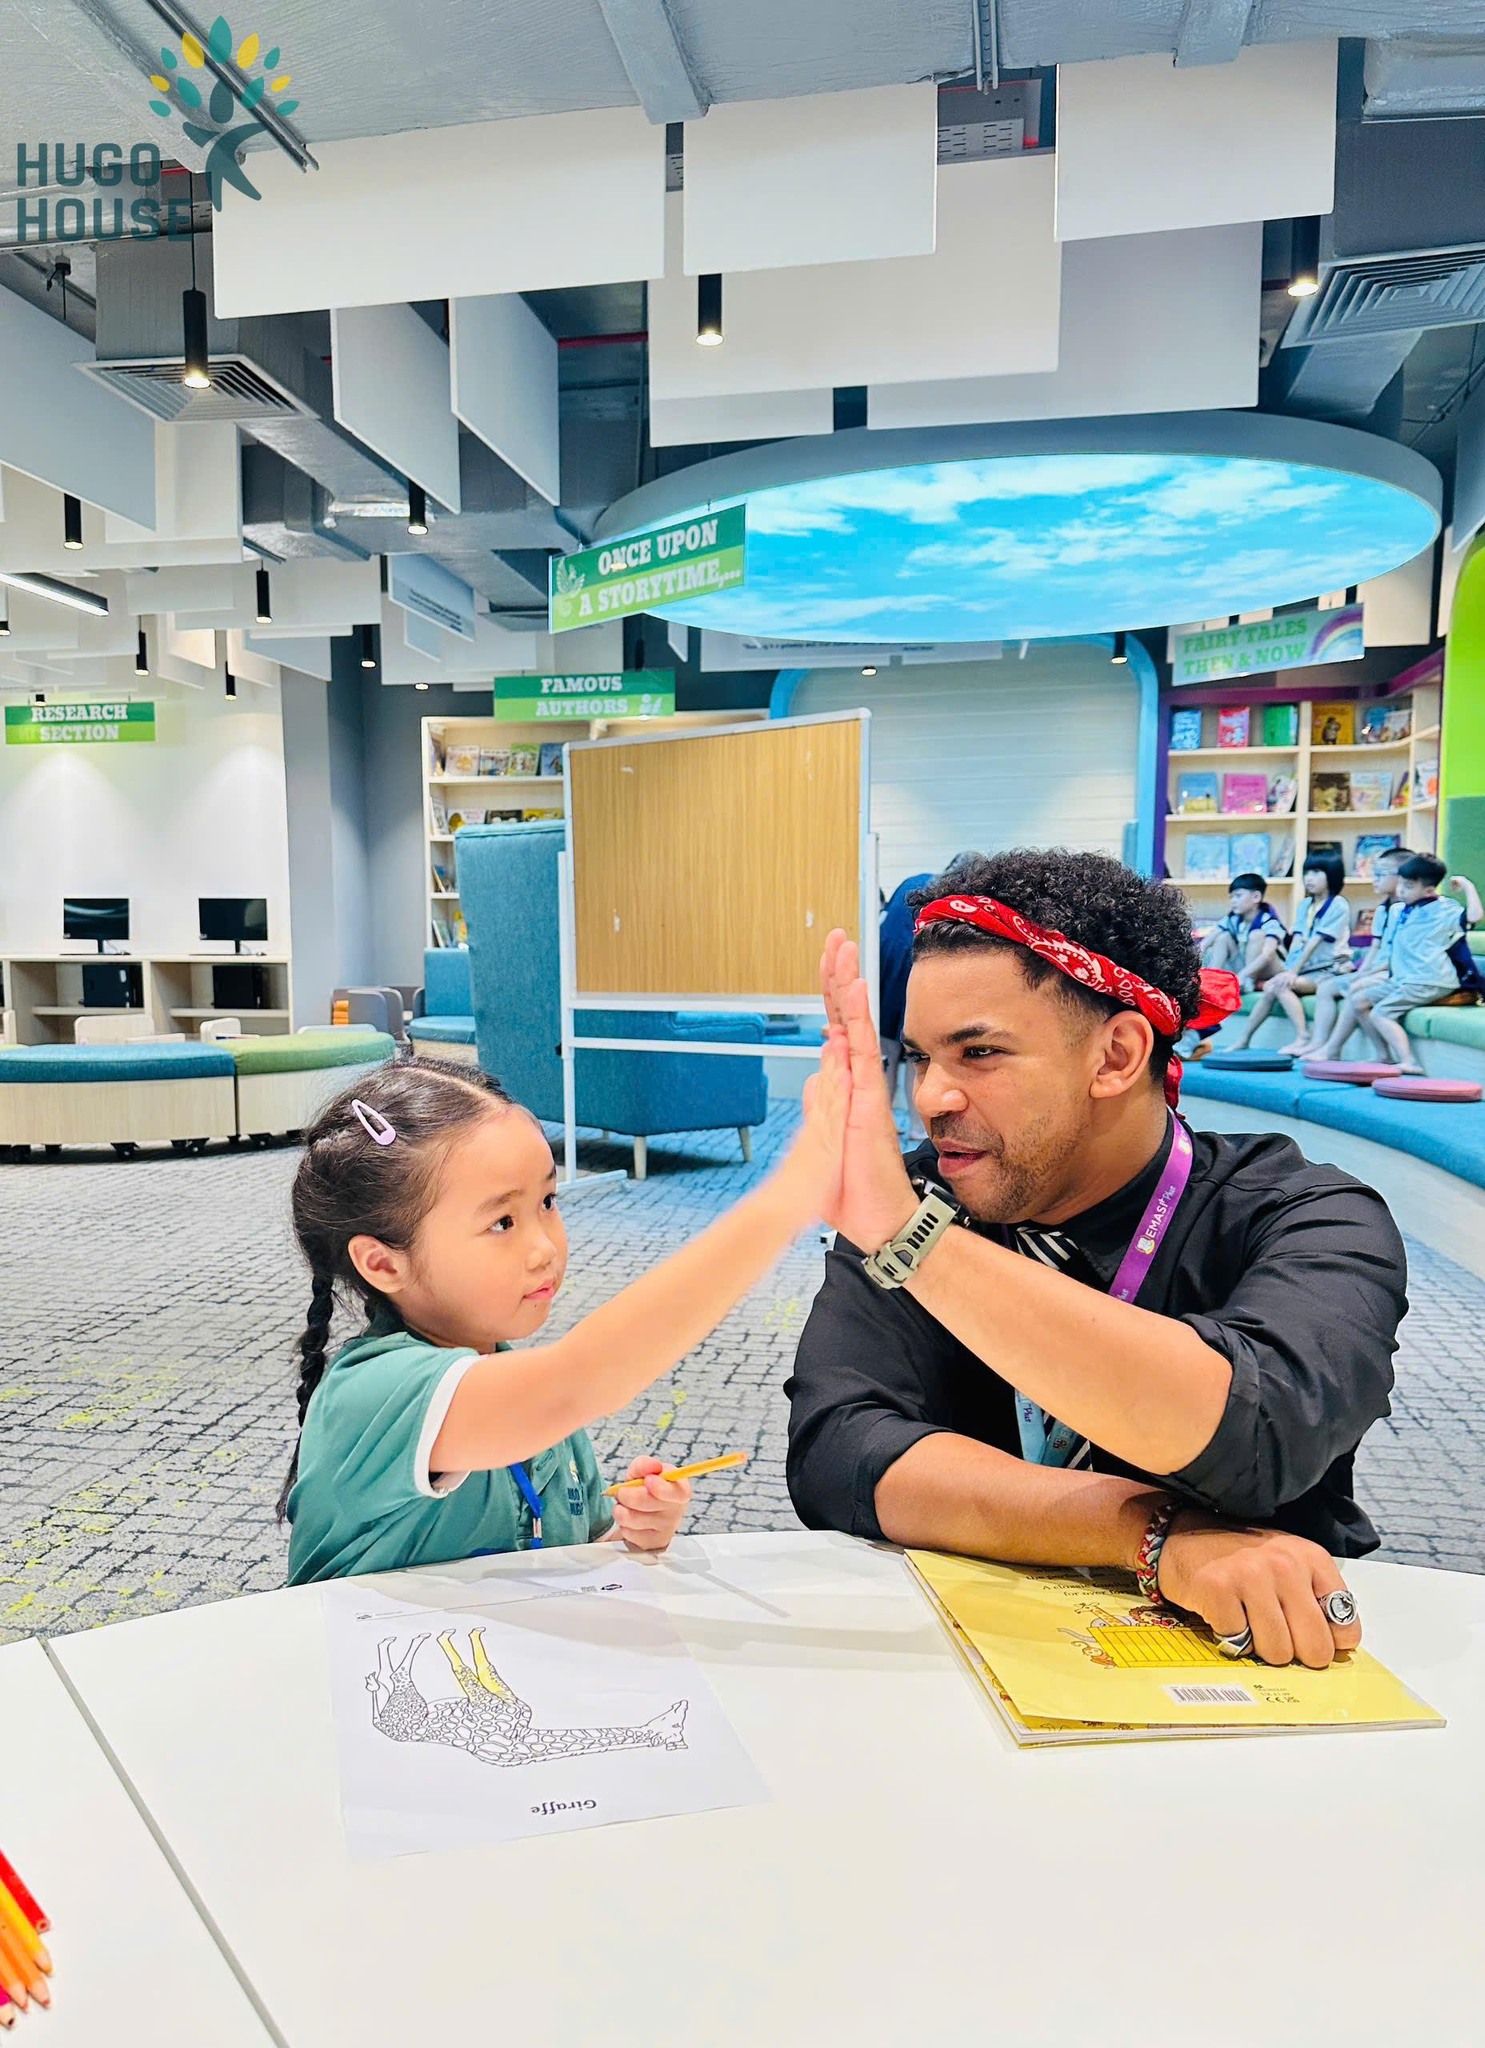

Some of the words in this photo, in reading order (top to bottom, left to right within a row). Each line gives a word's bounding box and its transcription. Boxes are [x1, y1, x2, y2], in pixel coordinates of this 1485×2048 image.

[599, 538, 652, 576] ONCE
[657, 519, 719, 558] UPON
[579, 591, 594, 617] A
[1185, 631, 1242, 653] FAIRY
[1246, 619, 1307, 642] TALES
[1184, 654, 1234, 675] THEN
[1238, 654, 1252, 668] &
[1257, 643, 1306, 664] NOW
[540, 675, 623, 694] FAMOUS
[31, 704, 128, 722] RESEARCH
[535, 698, 629, 717] AUTHORS
[40, 724, 120, 741] SECTION
[530, 1799, 597, 1815] Giraffe
